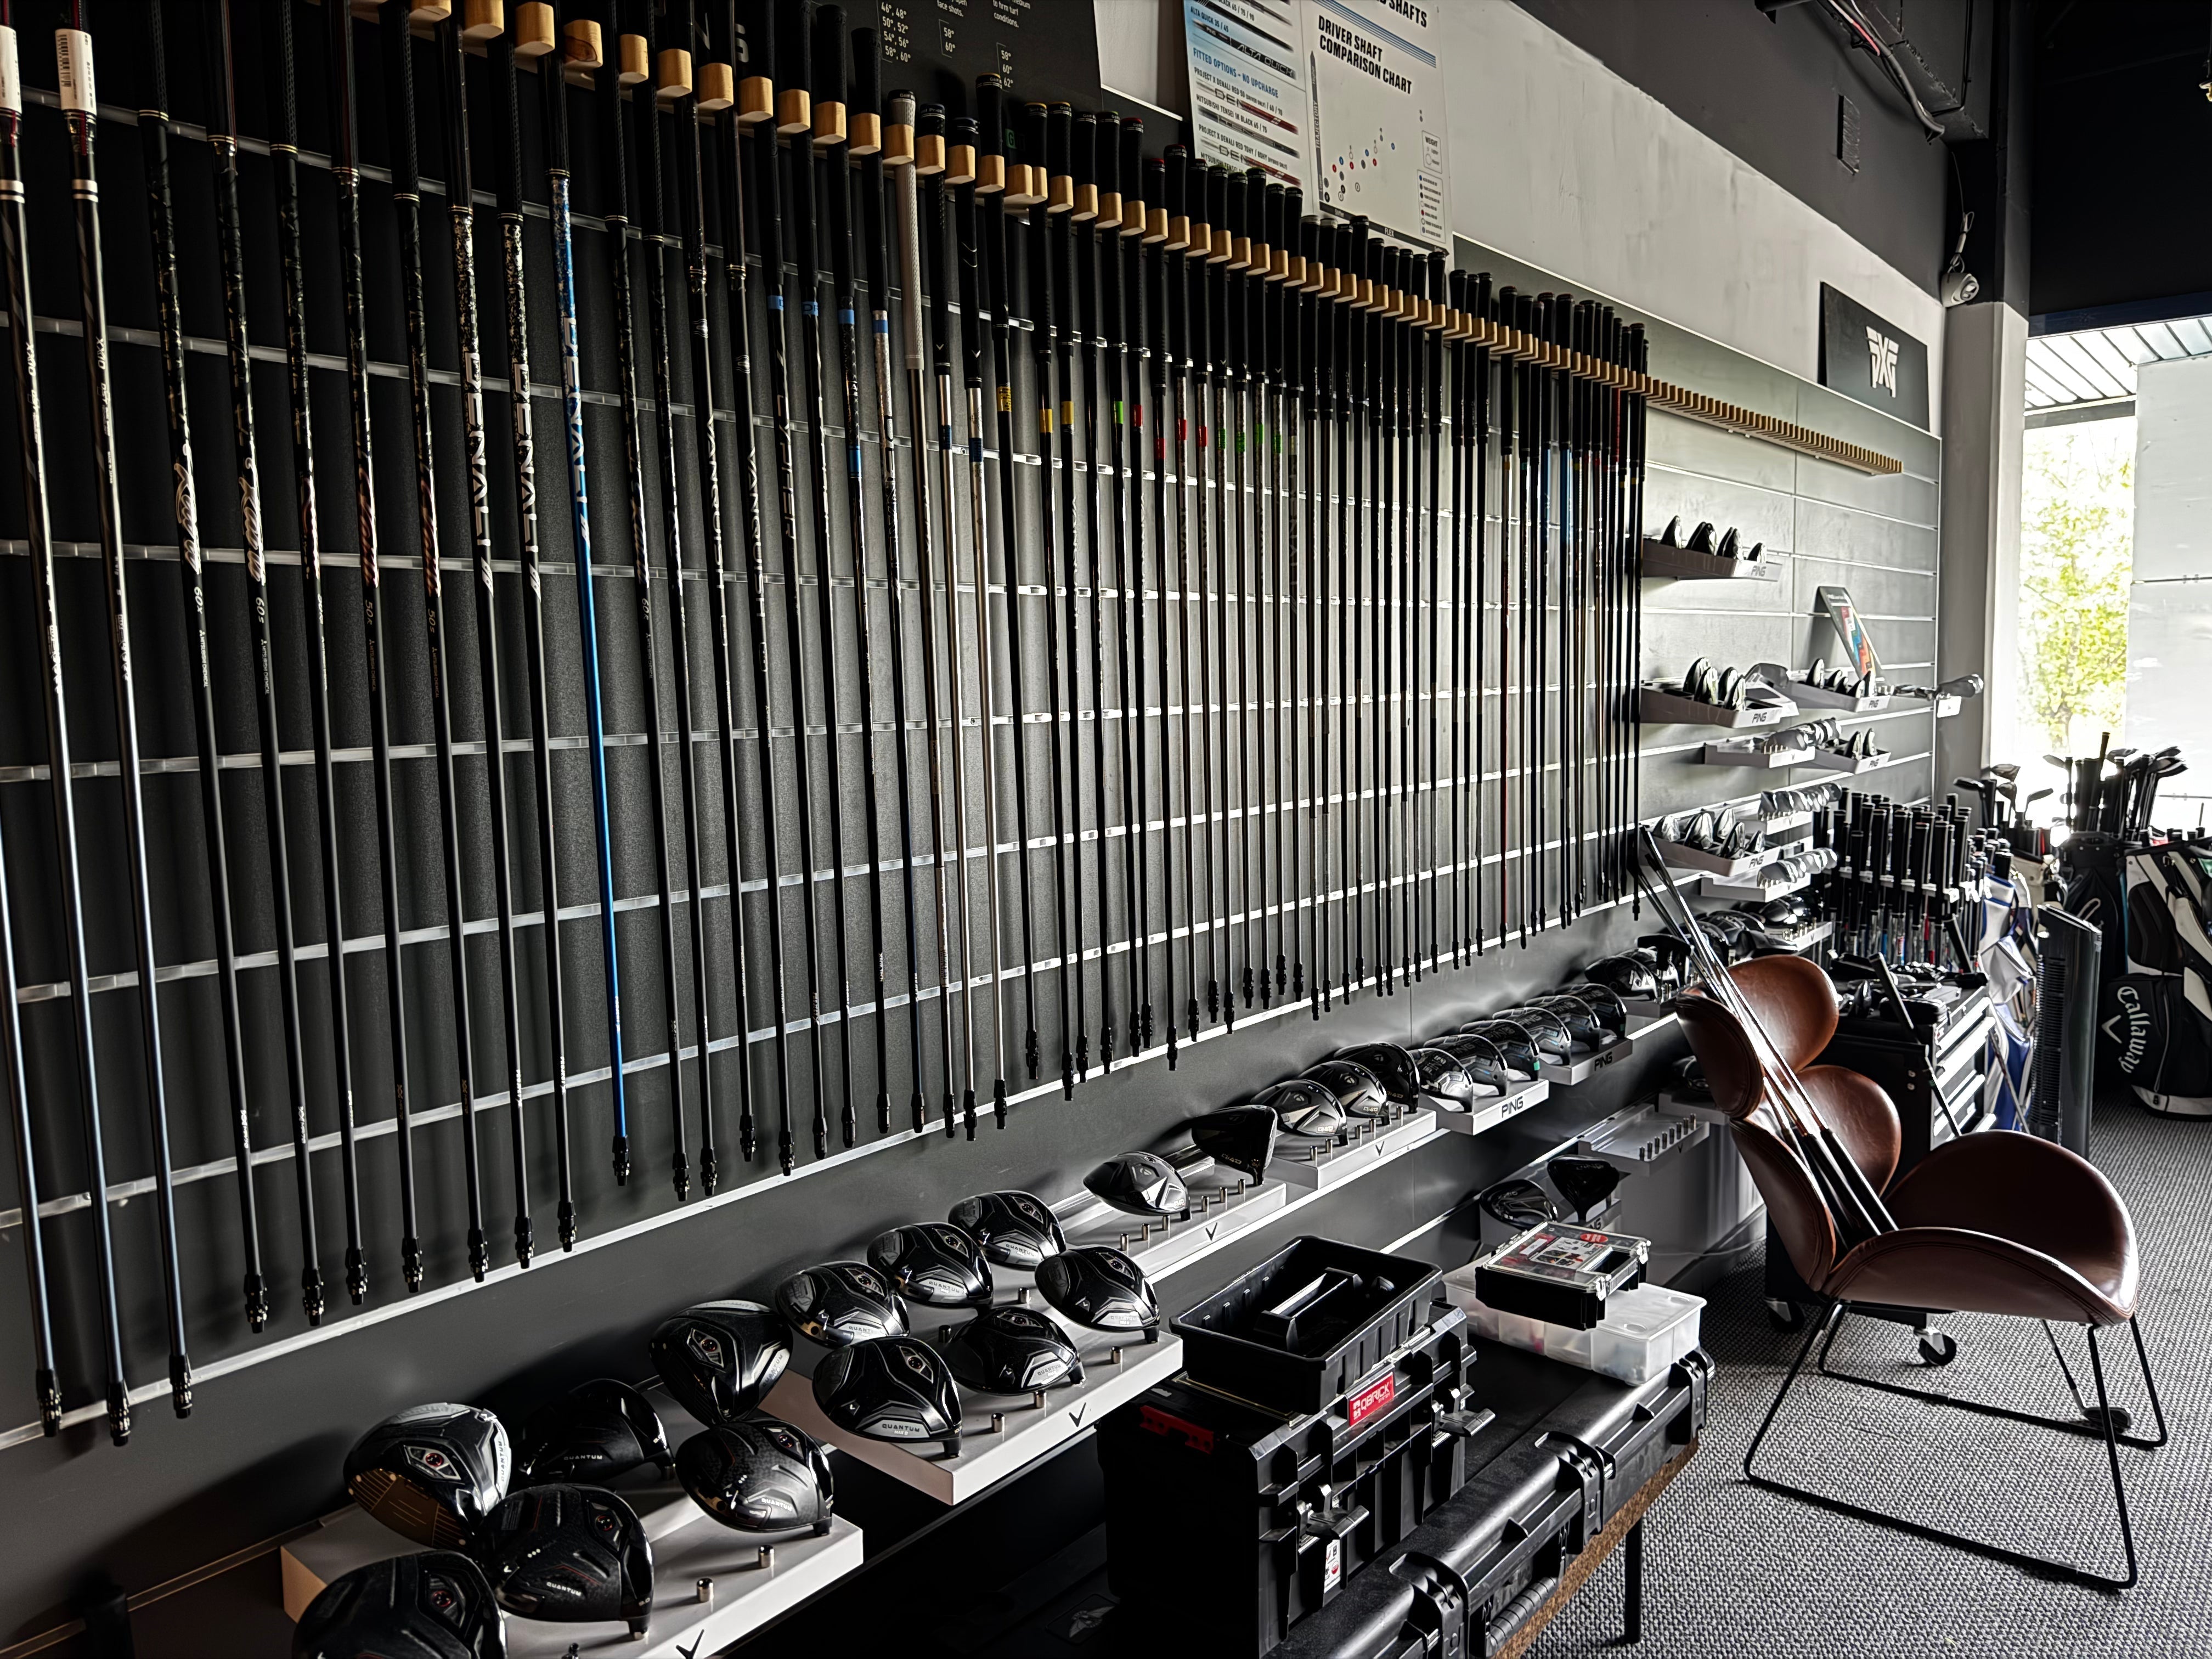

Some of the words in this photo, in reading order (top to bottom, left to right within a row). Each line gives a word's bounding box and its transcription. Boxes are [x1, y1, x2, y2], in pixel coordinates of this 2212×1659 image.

[896, 8, 907, 19] 48°
[949, 5, 964, 17] shots.
[998, 2, 1009, 12] firm
[1009, 6, 1019, 15] turf
[1190, 6, 1200, 16] ALTA
[1201, 11, 1214, 24] QUICK
[1389, 0, 1427, 28] SHAFTS
[897, 22, 908, 33] 52°
[994, 12, 1019, 28] conditions.
[944, 27, 955, 38] 58°
[1318, 15, 1352, 47] DRIVER
[1354, 35, 1383, 63] SHAFT
[898, 36, 909, 48] 56°
[945, 42, 956, 53] 60°
[900, 51, 911, 63] 60°
[1001, 50, 1012, 60] 58°
[1237, 44, 1261, 60] ALTA
[1265, 58, 1293, 76] QUICK
[1002, 64, 1012, 74] 60°
[1193, 47, 1212, 64] FITTED
[1214, 60, 1237, 77] OPTIONS
[1243, 73, 1250, 83] NO
[1251, 79, 1278, 98] UPCHARGE
[1320, 35, 1381, 80] COMPARISON
[1383, 68, 1412, 94] CHART
[1003, 77, 1013, 88] 62°
[1194, 67, 1212, 80] PROJECT
[1217, 78, 1231, 91] DENALI
[1196, 94, 1220, 109] MITSUBISHI
[1220, 105, 1234, 117] TENSEI
[1240, 115, 1253, 127] BLACK
[1199, 124, 1216, 137] PROJECT
[1221, 134, 1235, 146] DENALI
[1425, 136, 1438, 147] WEIGHT
[1385, 227, 1394, 238] FLEX
[95, 336, 106, 370] XXIO
[1866, 326, 1899, 398] PXG
[563, 317, 587, 504] DENALI
[465, 352, 491, 546] DENALI
[514, 363, 538, 552] DENALI
[777, 394, 797, 540] CYPHER
[707, 414, 724, 589] VANQUISH
[747, 447, 765, 617] VANQUISH
[1751, 563, 1766, 577] PING
[1752, 712, 1768, 724] PING
[1748, 855, 1764, 868] PING
[2117, 986, 2151, 1073] Callaway
[1595, 1052, 1612, 1071] PING
[1502, 1096, 1523, 1118] PING
[929, 1282, 960, 1294] QUANTUM
[1361, 1381, 1390, 1410] QBRICK
[882, 1423, 920, 1432] QUANTUM
[761, 1498, 793, 1511] QUANTUM
[546, 1582, 582, 1596] QUANTUM
